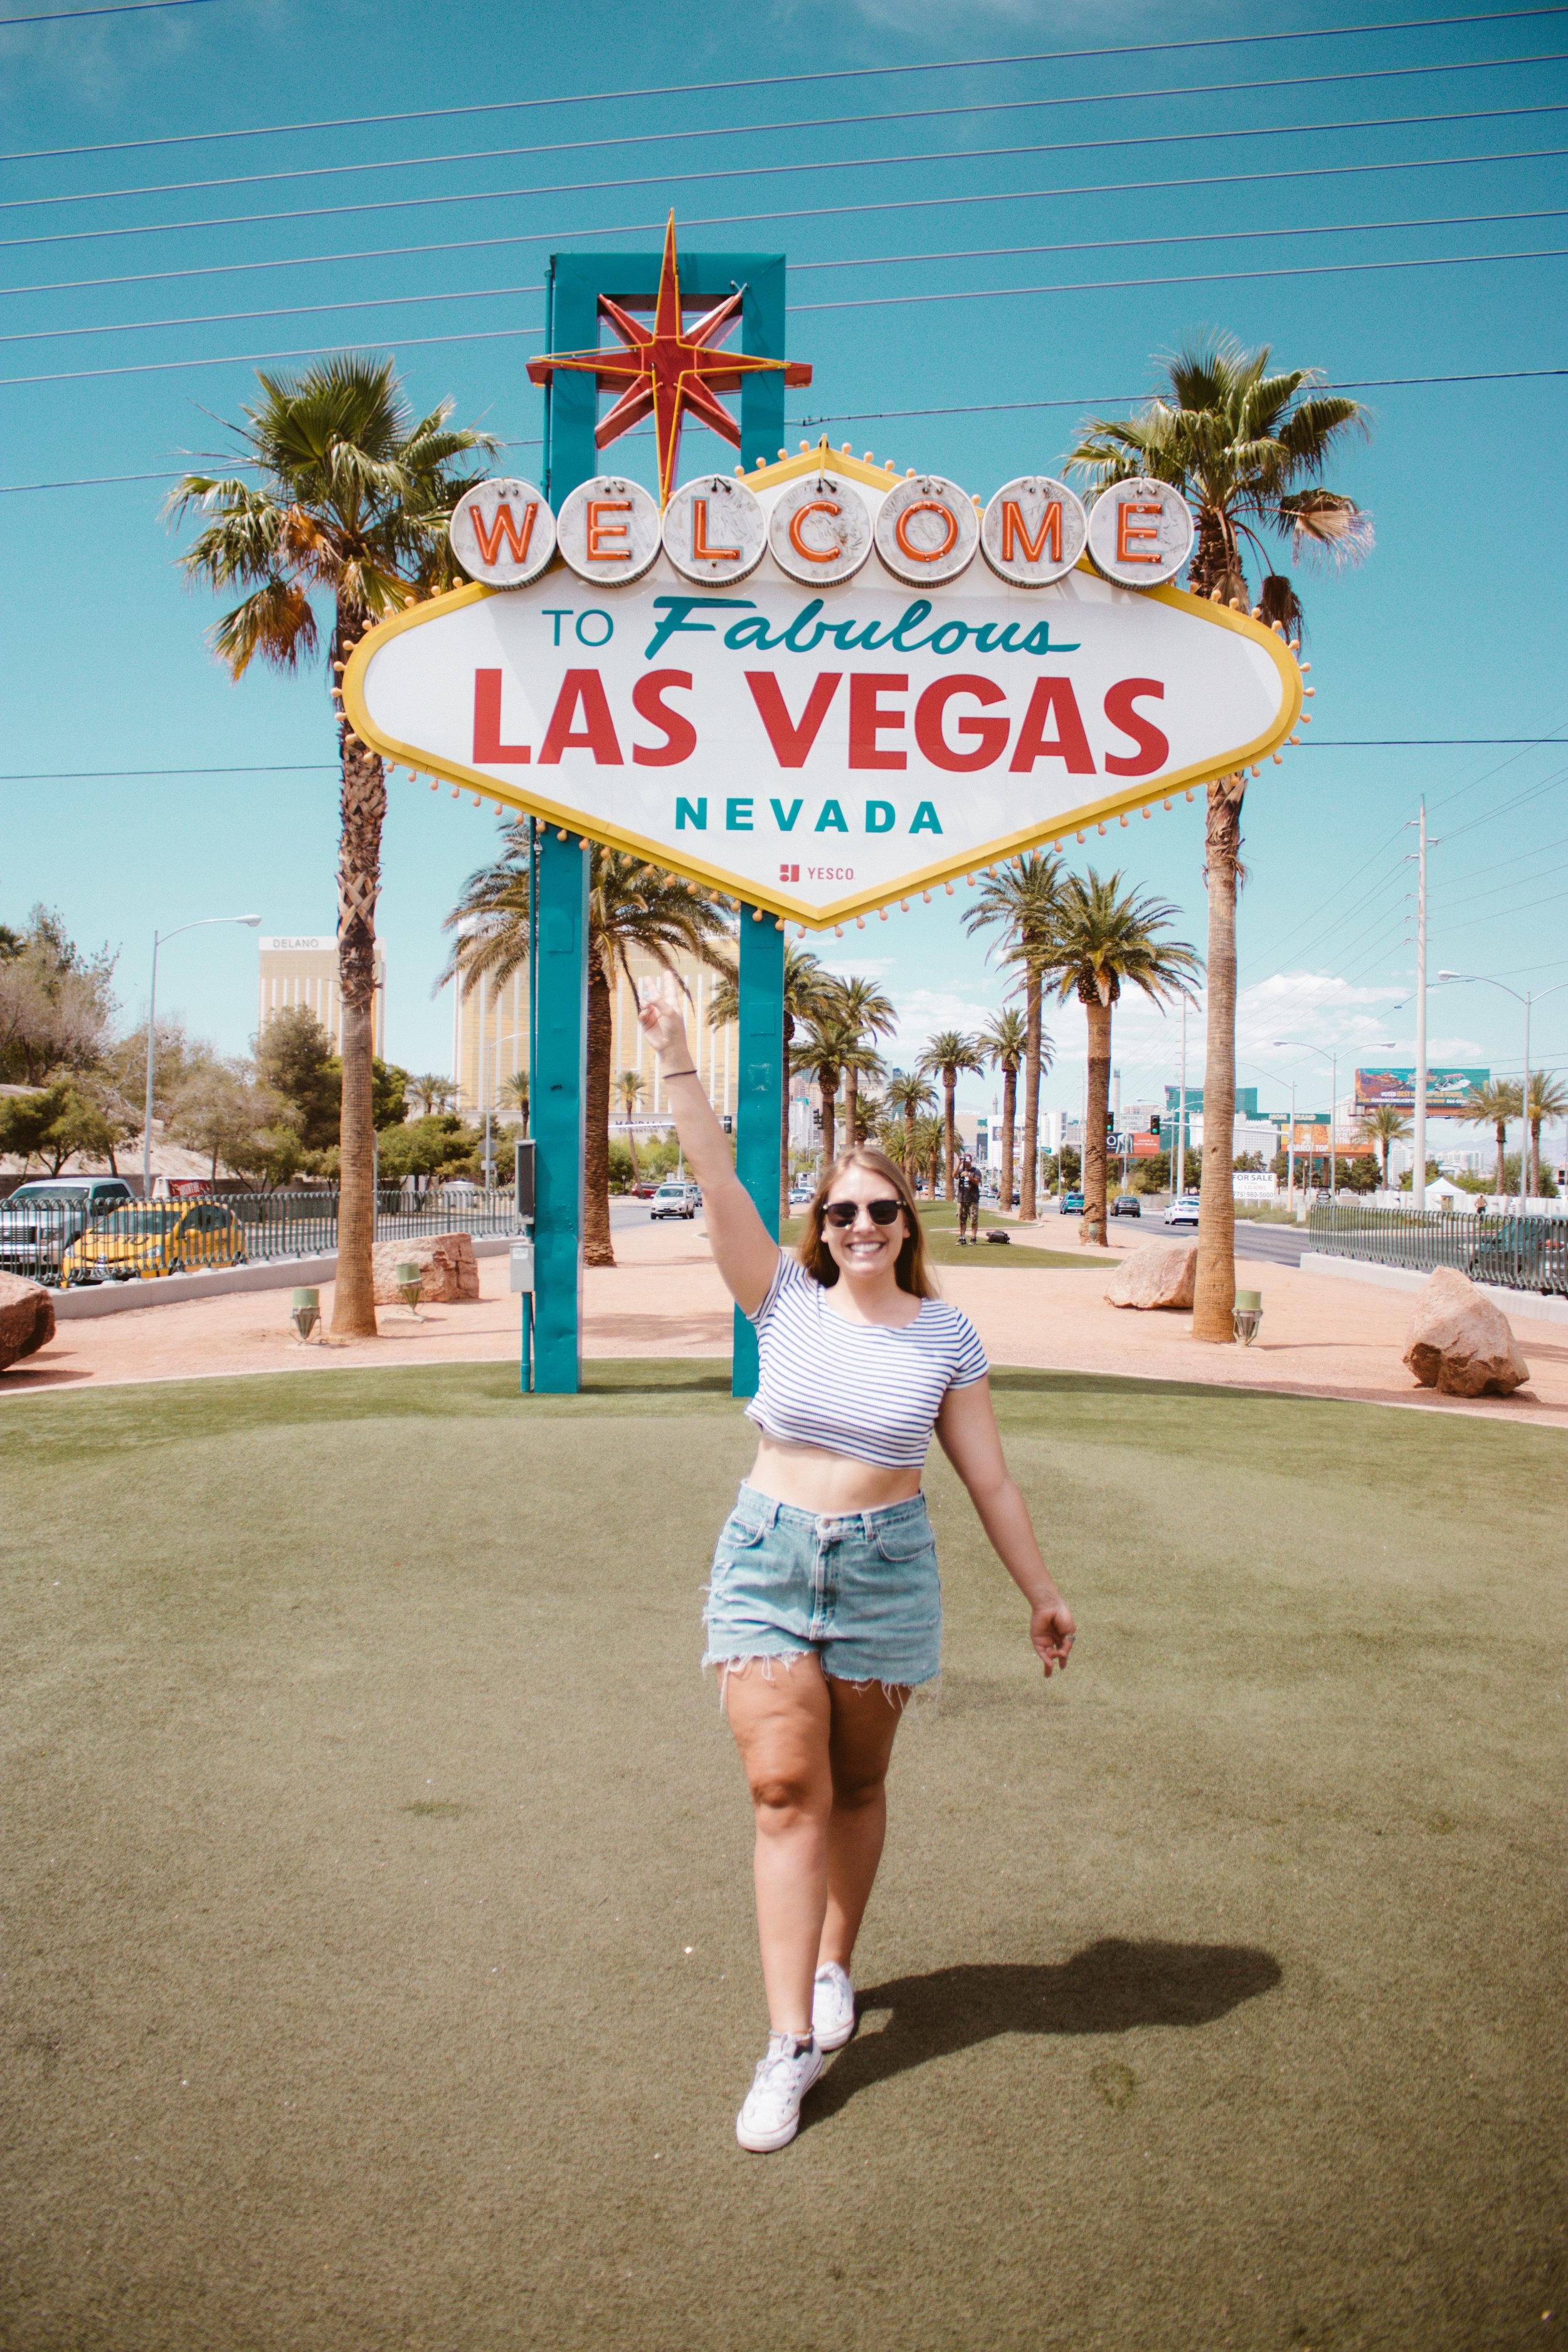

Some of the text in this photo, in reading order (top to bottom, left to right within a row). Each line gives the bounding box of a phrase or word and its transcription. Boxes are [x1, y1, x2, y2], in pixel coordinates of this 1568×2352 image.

[469, 501, 1162, 566] WELCOME
[542, 596, 1081, 660] TO Fabulous
[473, 669, 1170, 776] LAS VEGAS
[675, 797, 943, 834] NEVADA
[807, 867, 854, 881] YESCO
[273, 939, 319, 948] DELANO
[1315, 1144, 1328, 1152] TOP
